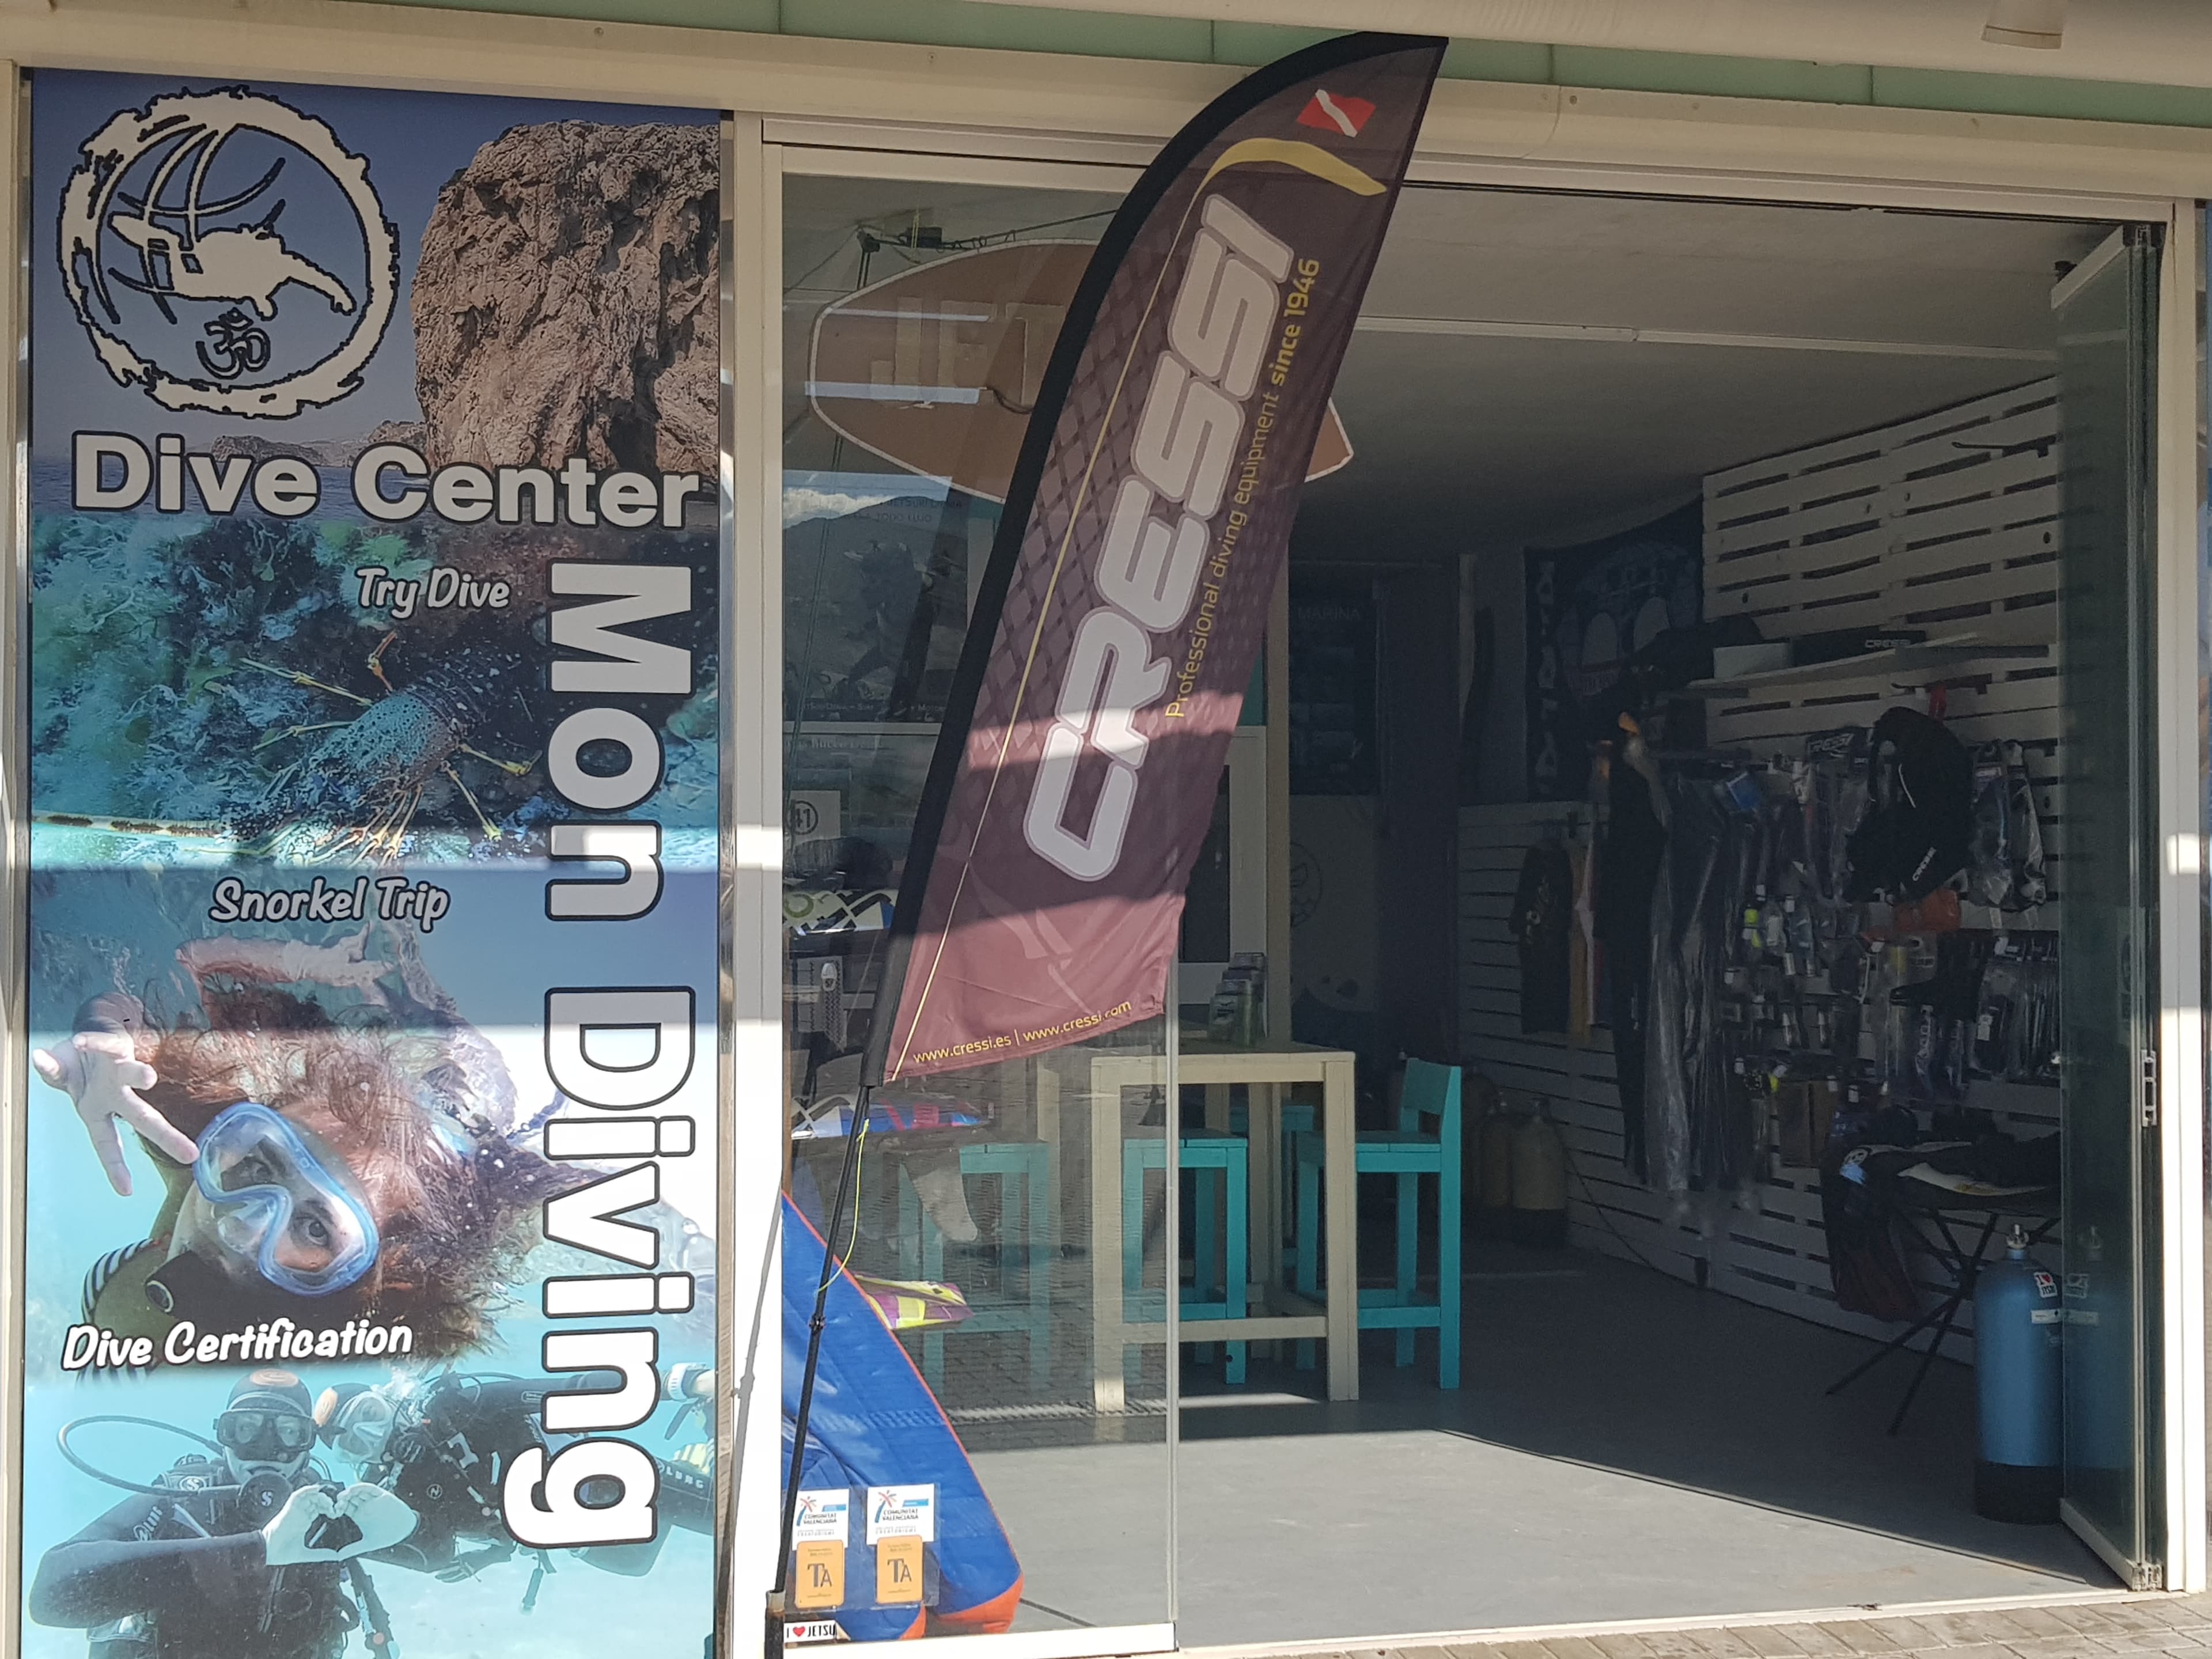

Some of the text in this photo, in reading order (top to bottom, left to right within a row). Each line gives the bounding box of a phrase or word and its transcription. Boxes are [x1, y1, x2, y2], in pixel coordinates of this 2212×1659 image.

[71, 431, 699, 529] Dive Center
[1165, 258, 1320, 718] Professional diving equipment since 1946
[1023, 193, 1294, 882] CRESSI
[355, 565, 510, 618] Try Dive
[209, 876, 451, 933] Snorkel Trip
[504, 560, 695, 1549] Mon Diving
[913, 1000, 1132, 1064] www.cressi.es www.cressi.com
[62, 1317, 414, 1369] Dive Certification
[807, 1563, 833, 1588] TA
[887, 1558, 912, 1583] TA
